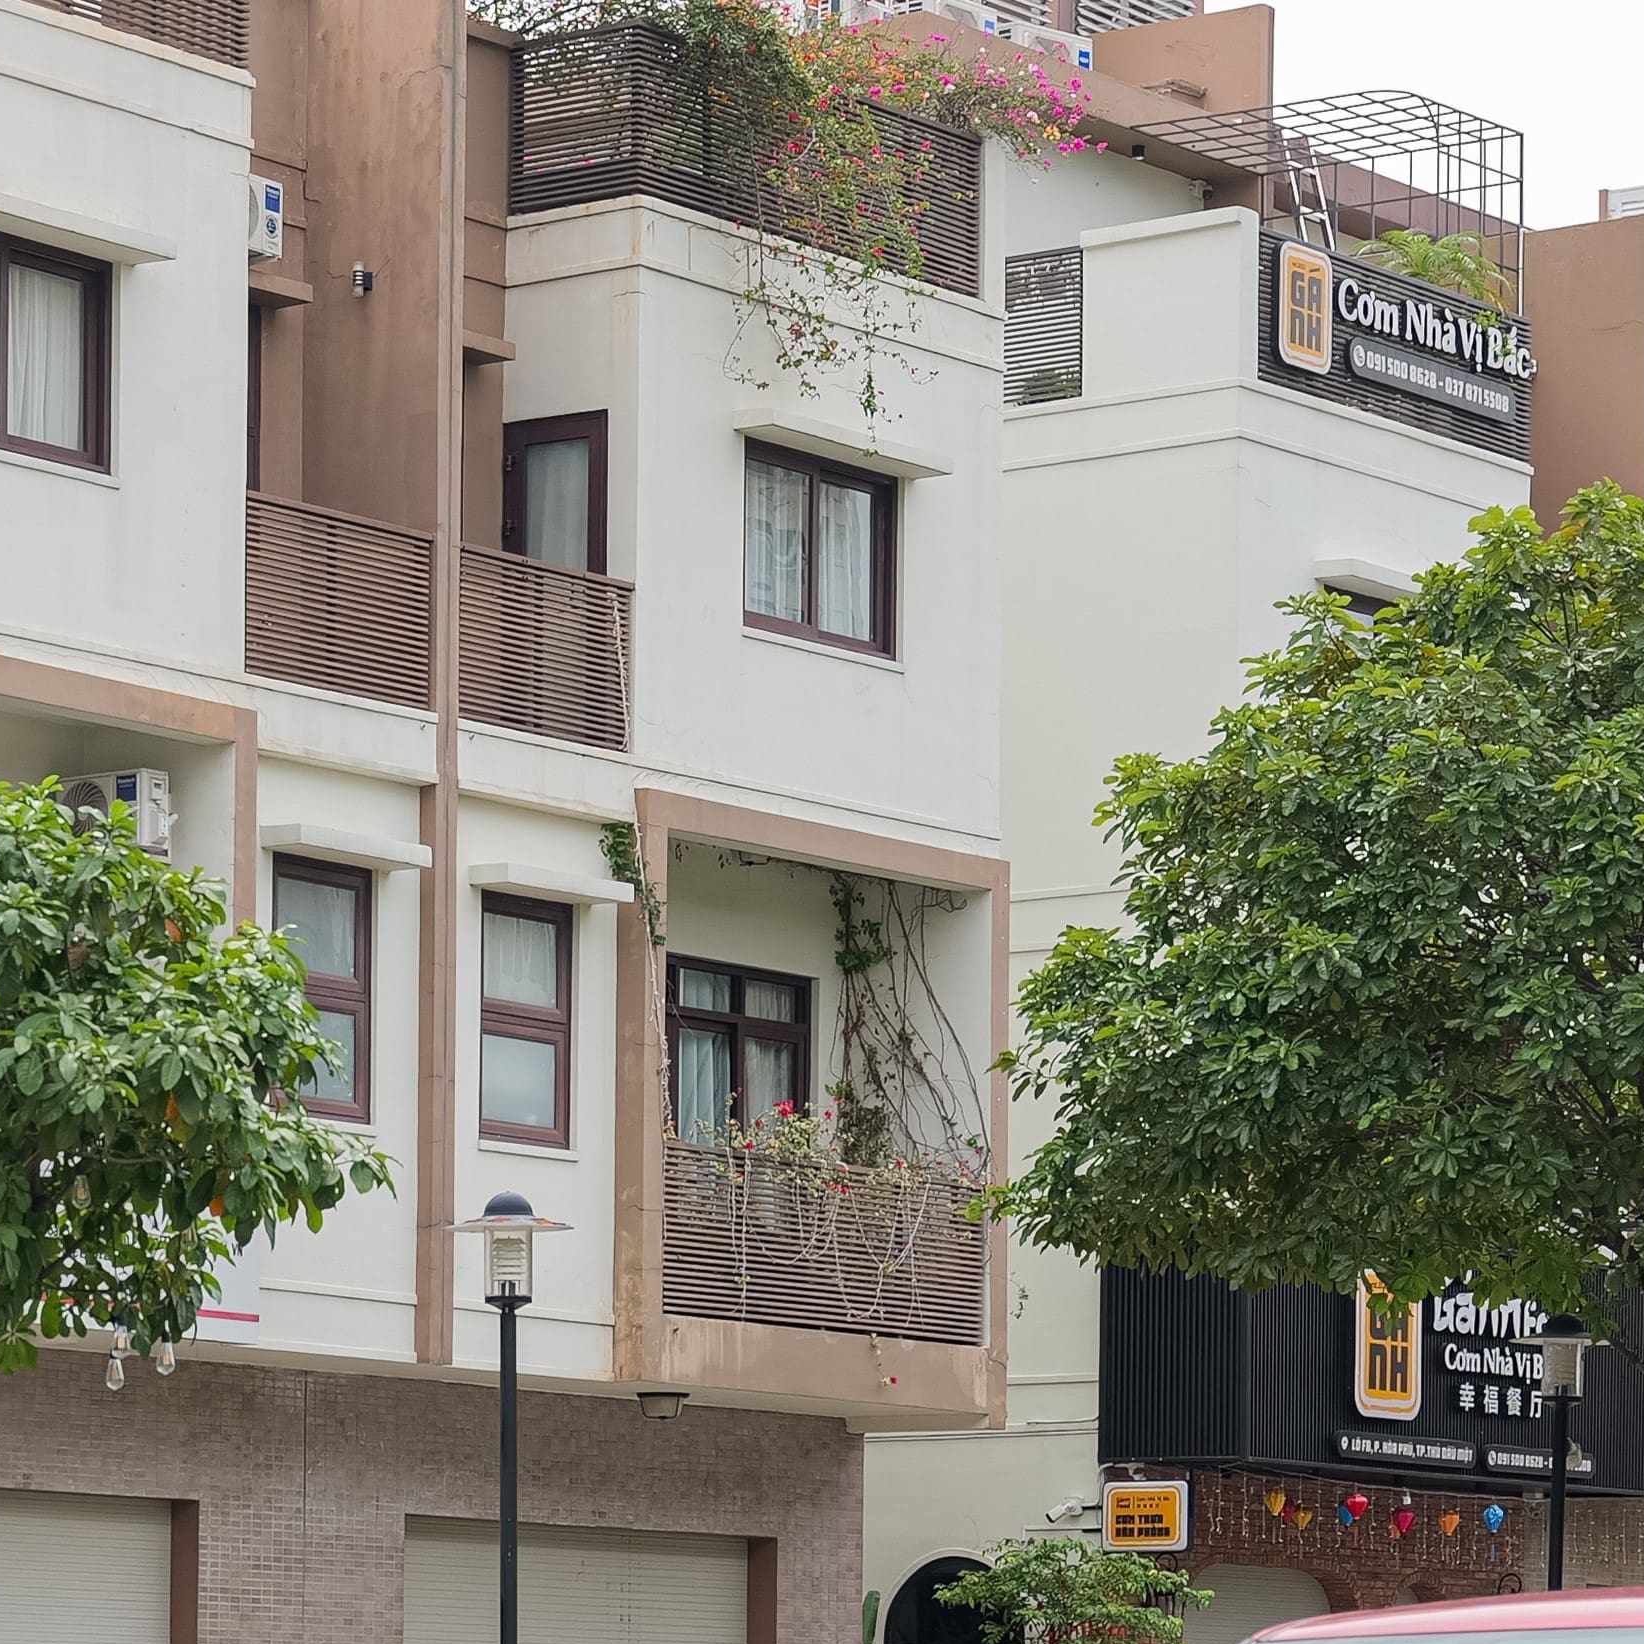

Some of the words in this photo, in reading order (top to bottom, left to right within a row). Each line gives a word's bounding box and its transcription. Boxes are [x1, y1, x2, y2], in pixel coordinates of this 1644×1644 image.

[1337, 278, 1400, 336] Cơm
[1405, 300, 1456, 354] Nhà
[1458, 318, 1483, 373] Vị
[1366, 351, 1386, 373] 091
[1387, 358, 1408, 380] 500
[1409, 364, 1437, 390] 8628
[1444, 1343, 1481, 1373] Cơm
[1483, 1347, 1513, 1377] Nhà
[1515, 1351, 1531, 1384] Vị
[1459, 1382, 1543, 1418] 幸福餐厅
